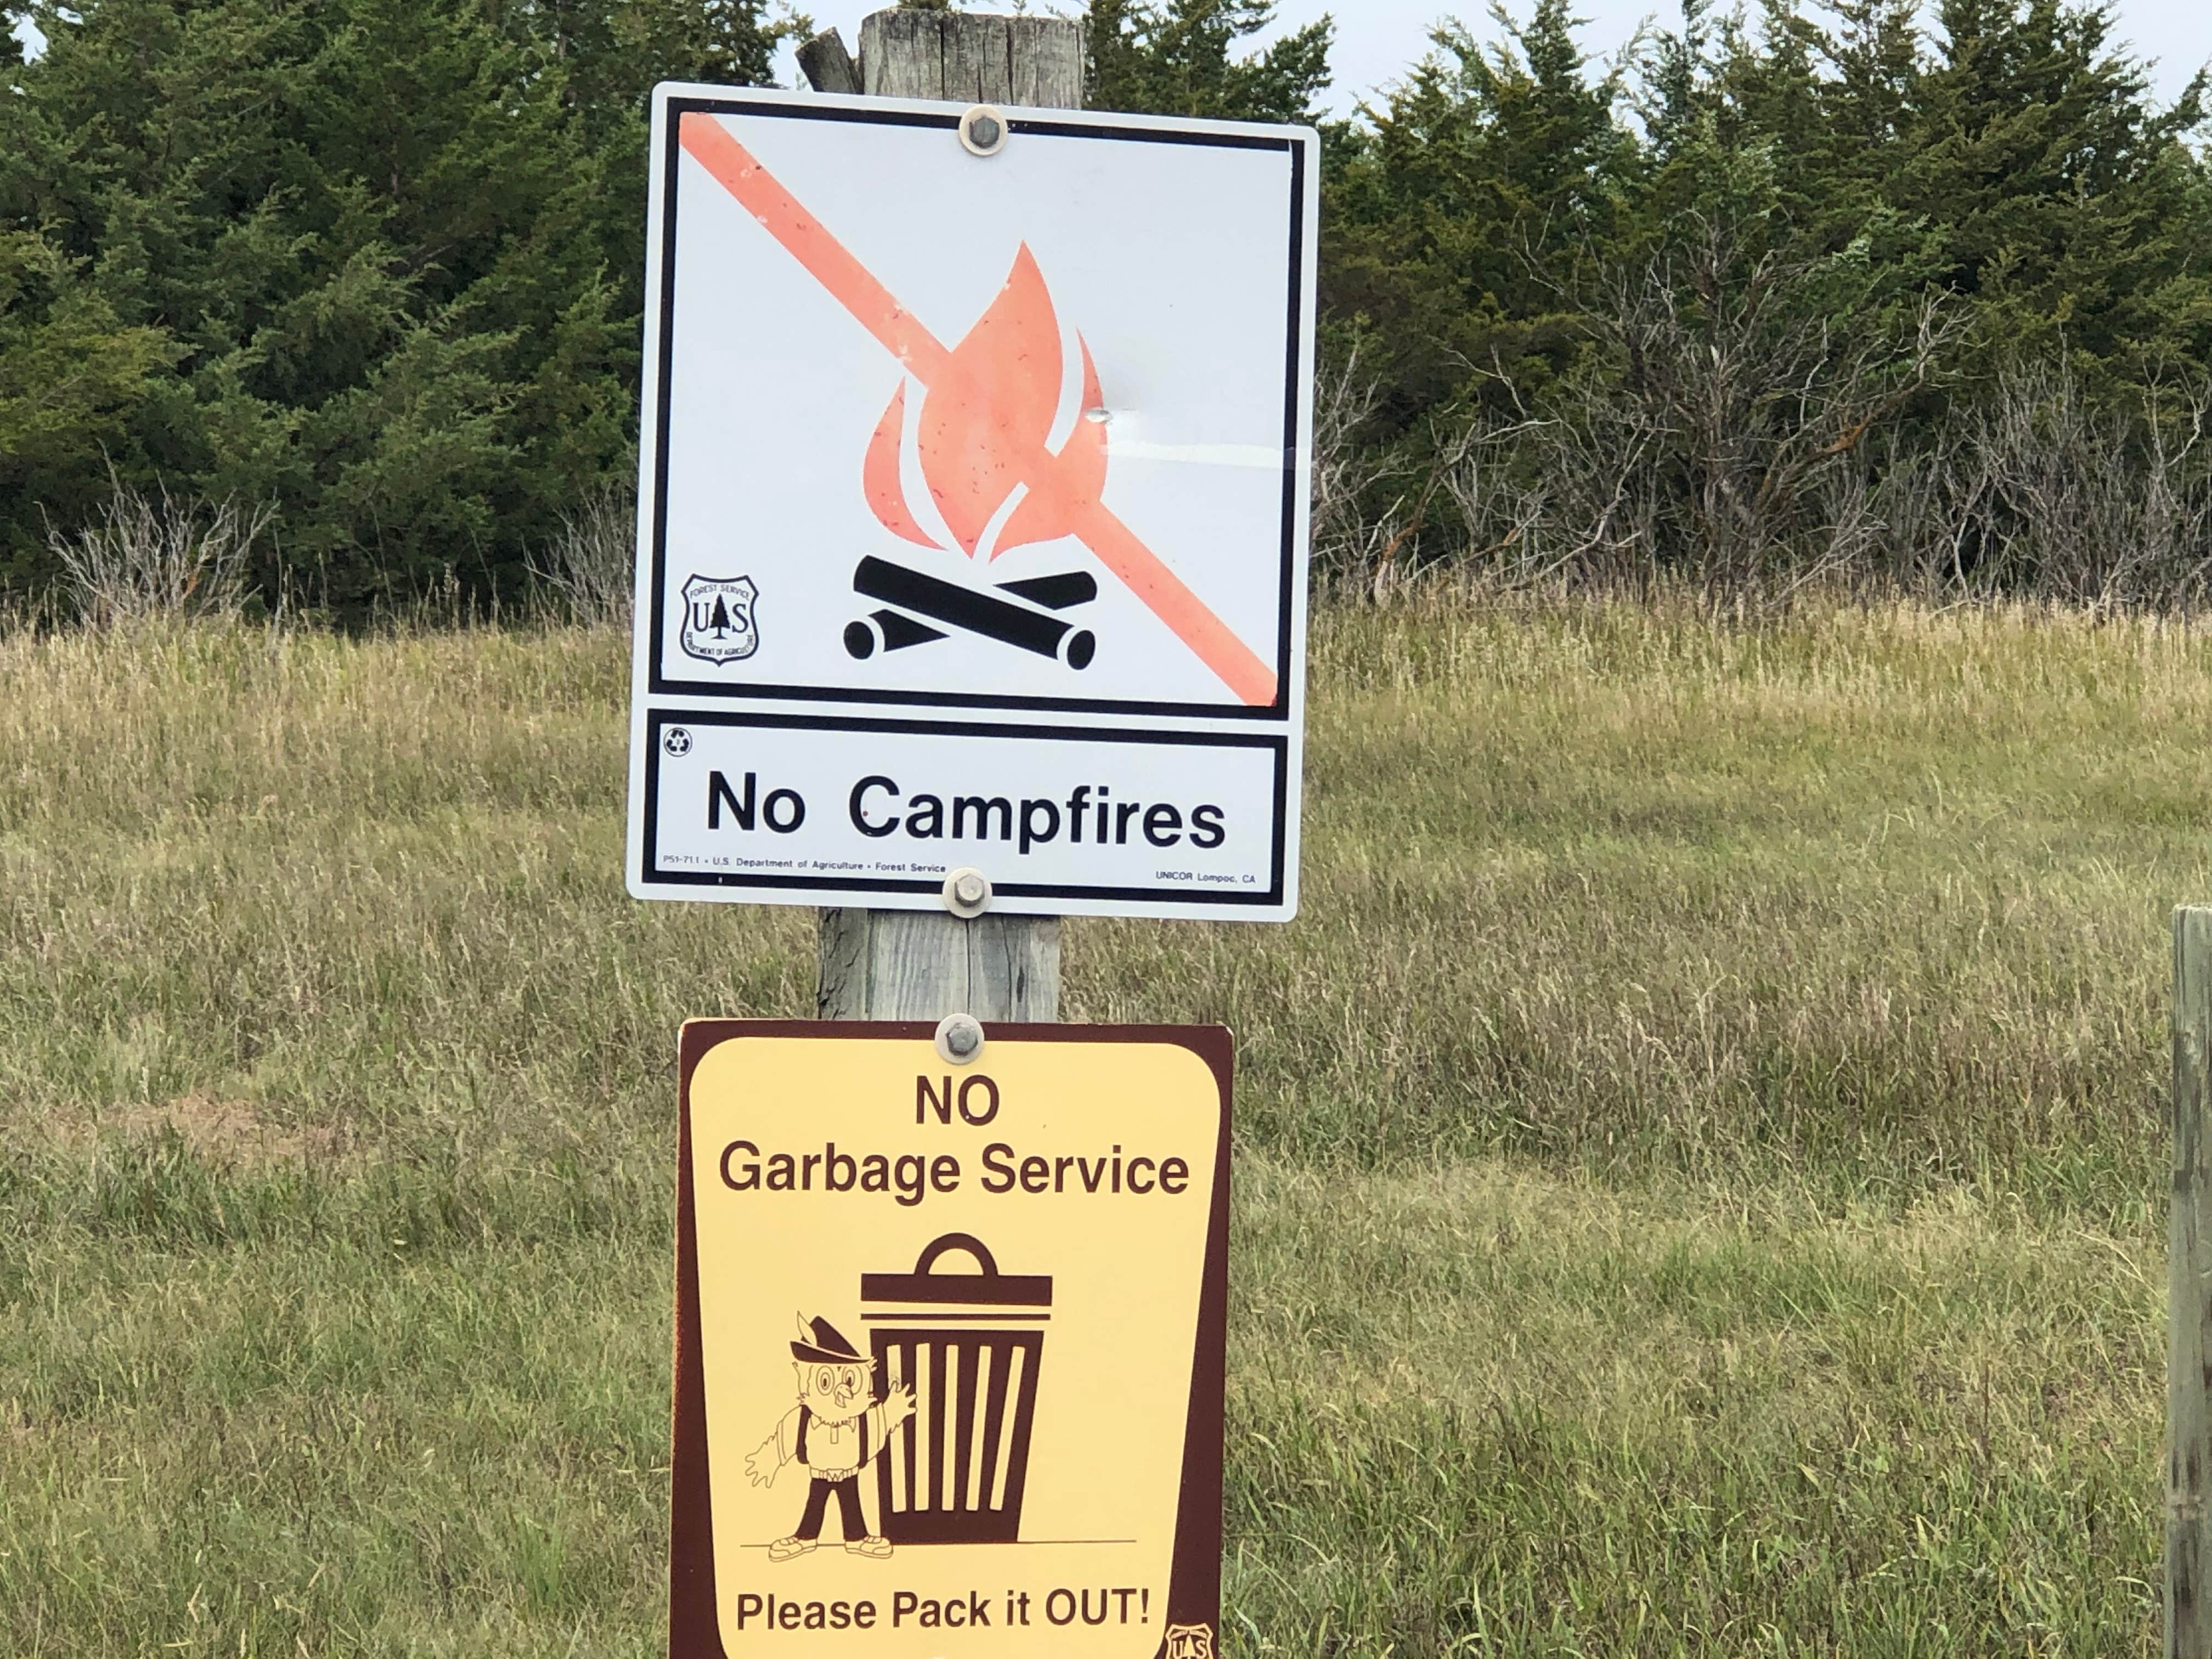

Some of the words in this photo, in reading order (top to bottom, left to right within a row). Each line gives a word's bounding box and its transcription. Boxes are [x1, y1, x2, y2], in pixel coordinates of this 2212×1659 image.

[690, 584, 716, 599] FOREST
[720, 584, 750, 601] SERVICE
[708, 770, 806, 834] No
[849, 775, 1225, 855] Campfires
[736, 857, 793, 867] Department
[797, 860, 808, 868] of
[812, 860, 864, 871] Agriculture
[875, 862, 906, 871] Forest
[911, 863, 946, 872] Service
[1156, 871, 1193, 881] UNICOR
[1197, 873, 1237, 884] Lompoc,
[1242, 874, 1256, 883] CA
[916, 1074, 1000, 1126] NO
[720, 1140, 961, 1207] Garbage
[980, 1143, 1189, 1194] Service
[737, 1593, 876, 1630] Please
[893, 1590, 991, 1628] Pack
[1007, 1589, 1031, 1626] it
[1046, 1588, 1149, 1626] OUT!
